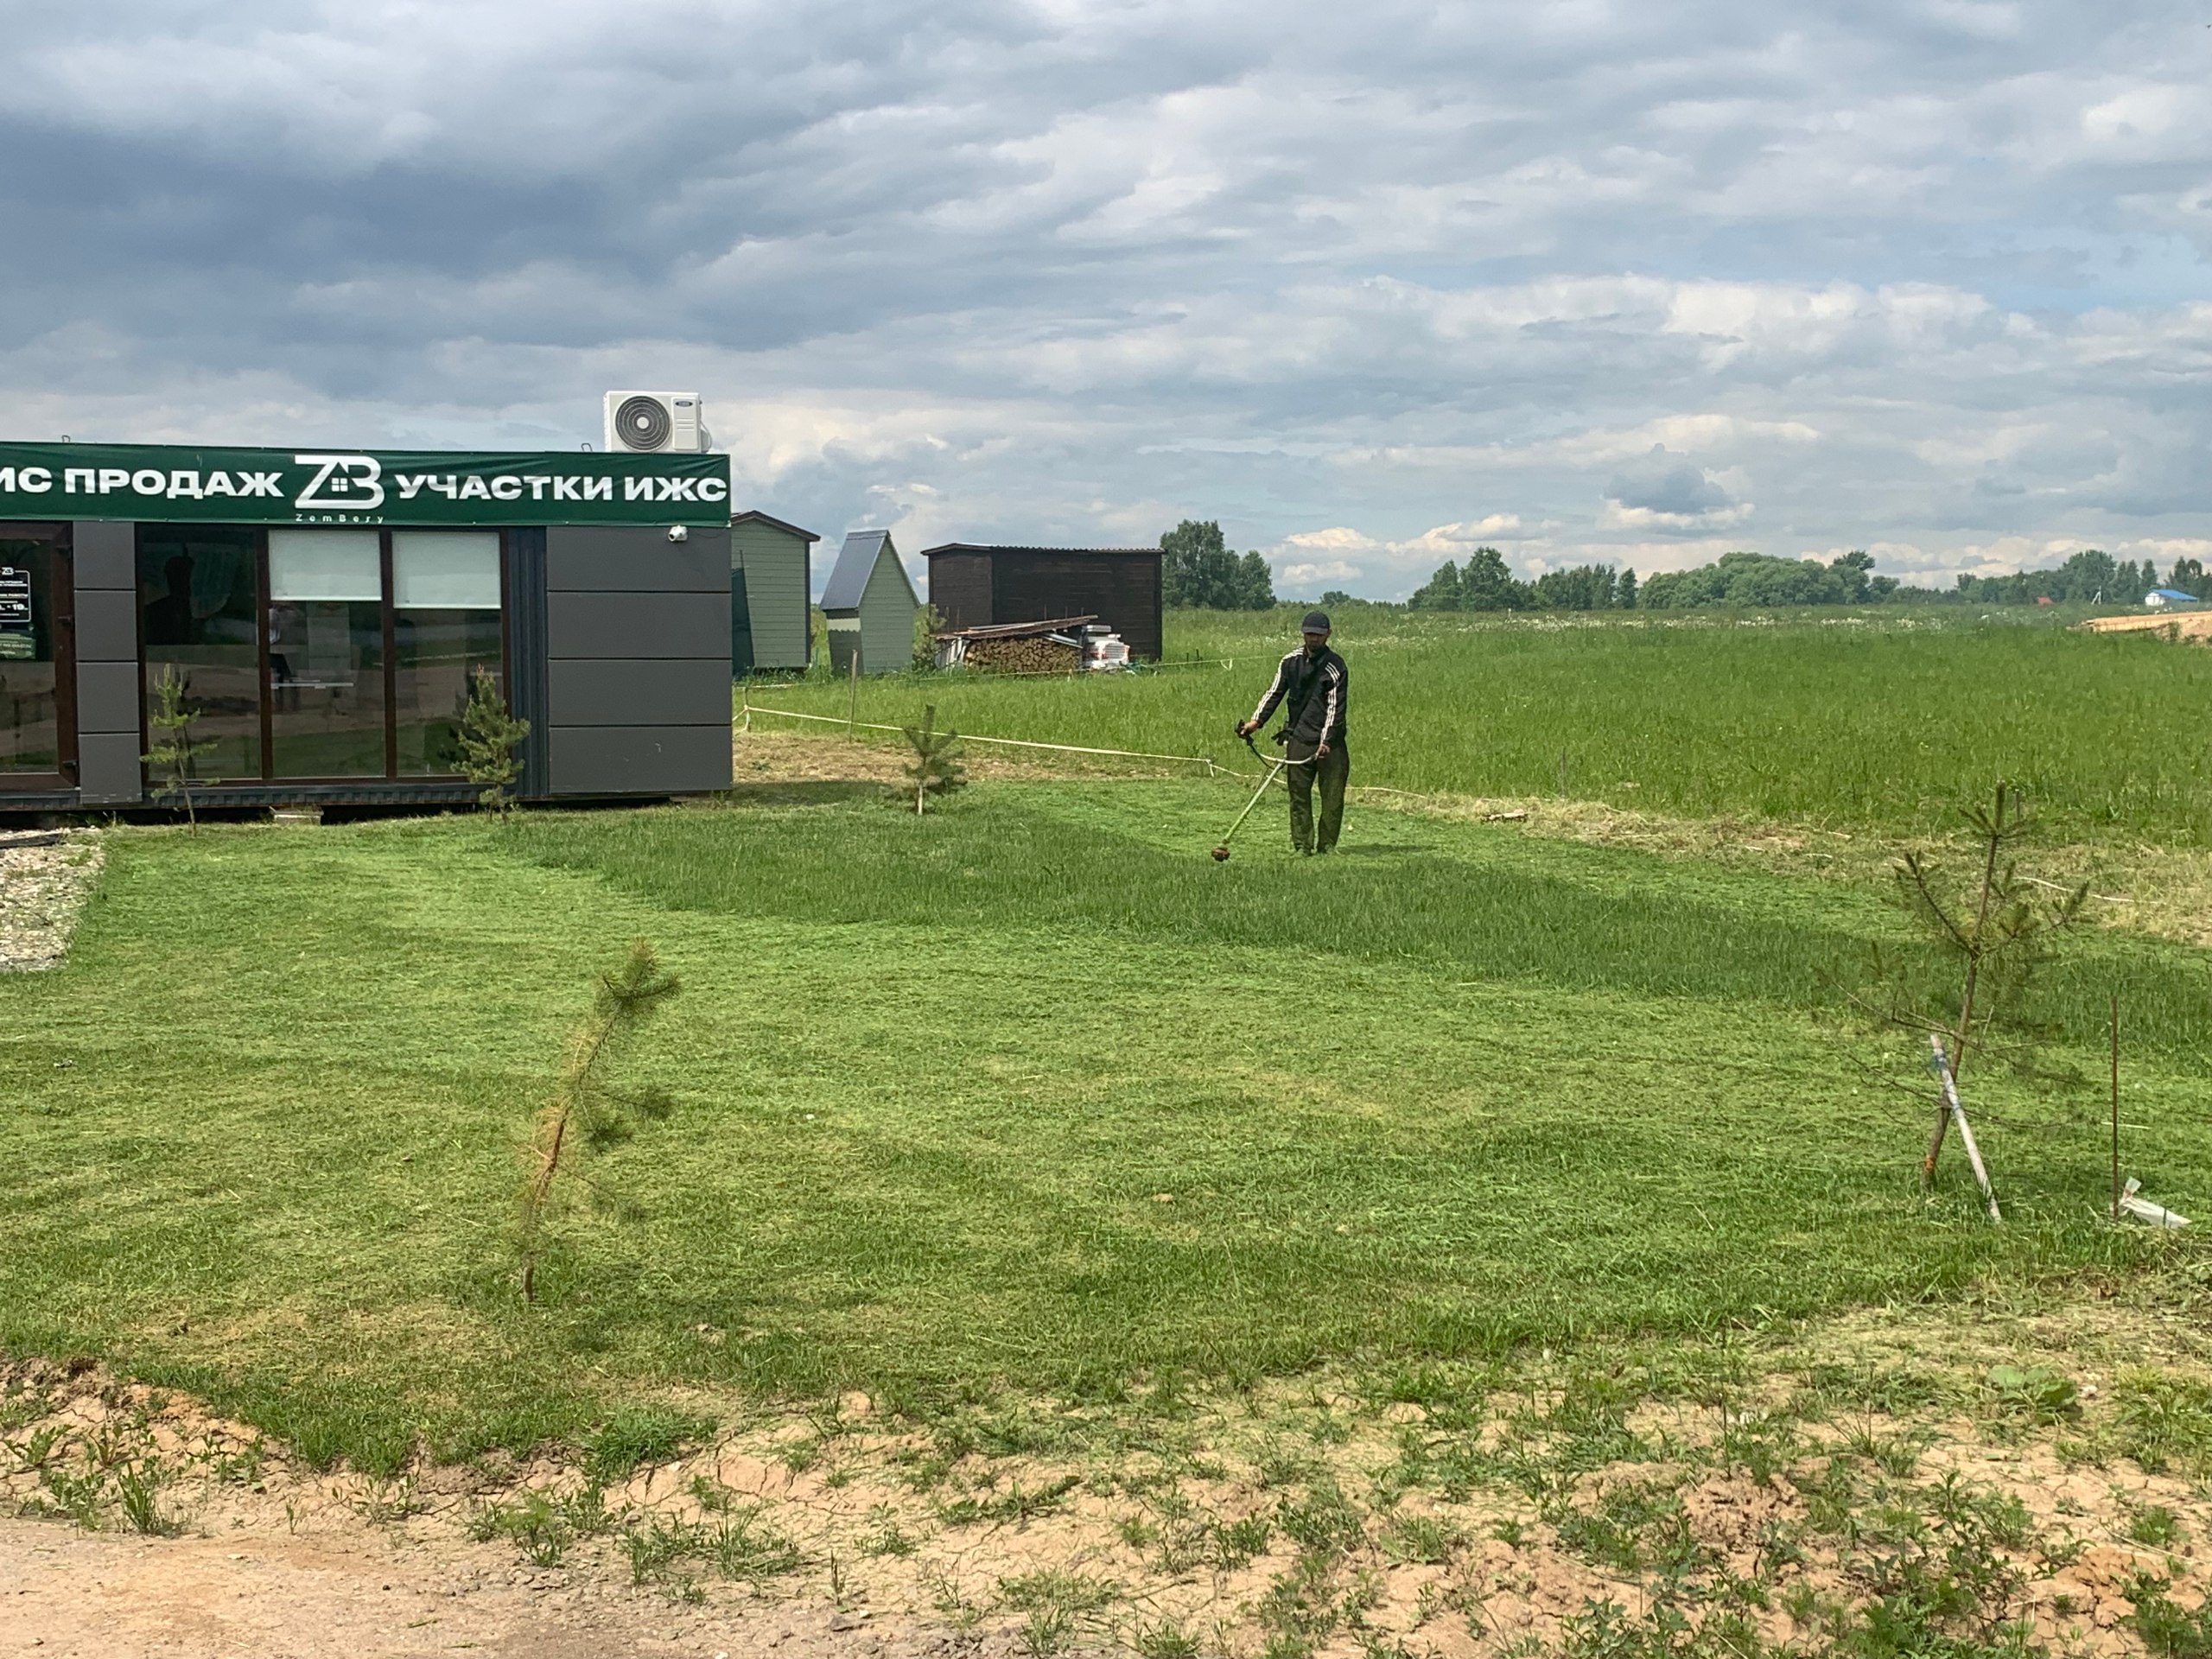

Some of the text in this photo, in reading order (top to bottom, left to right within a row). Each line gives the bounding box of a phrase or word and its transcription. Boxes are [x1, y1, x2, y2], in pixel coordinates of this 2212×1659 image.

[65, 468, 285, 499] ПРОДАЖ
[394, 474, 728, 502] УЧАСТКИ ИЖС
[296, 513, 384, 524] ZemBery
